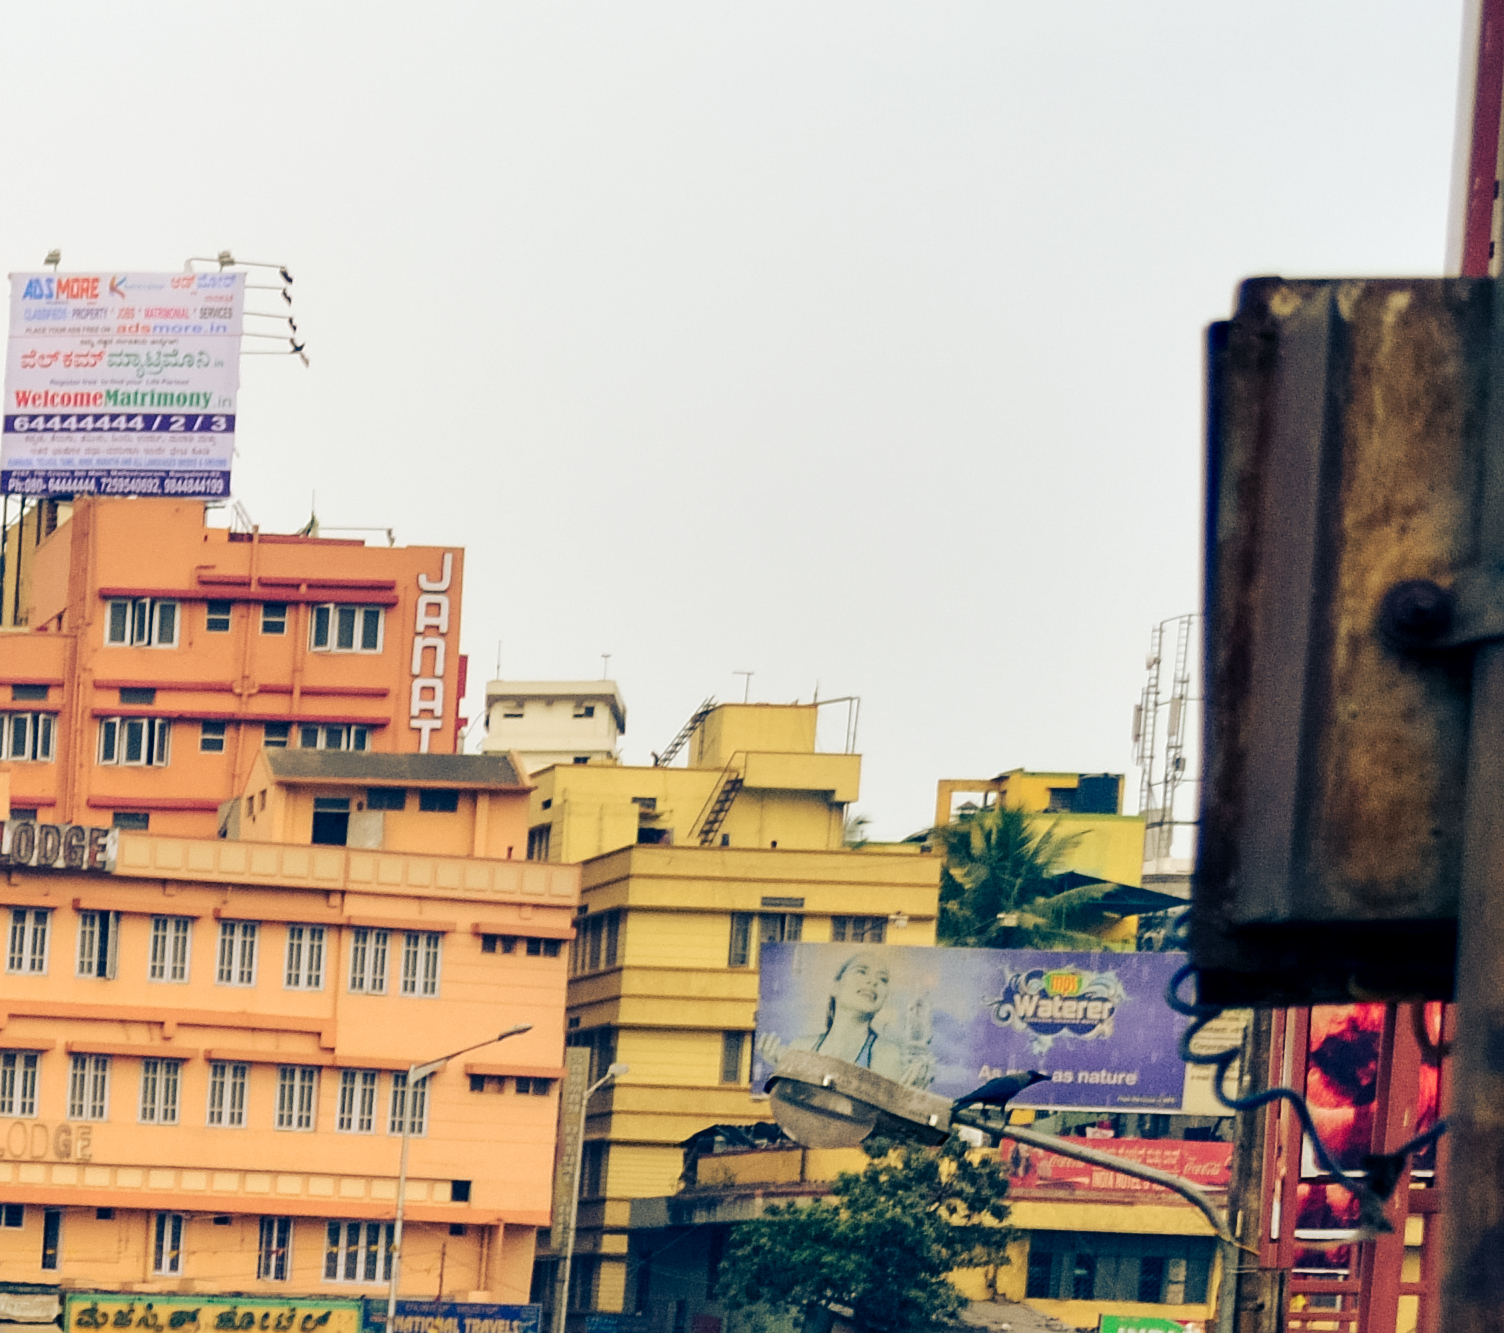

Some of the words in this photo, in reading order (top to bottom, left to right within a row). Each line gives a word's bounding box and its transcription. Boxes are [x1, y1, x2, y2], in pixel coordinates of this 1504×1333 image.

[116, 322, 228, 334] adsmore.in
[1013, 994, 1114, 1020] Waterer
[1077, 1068, 1138, 1086] nature
